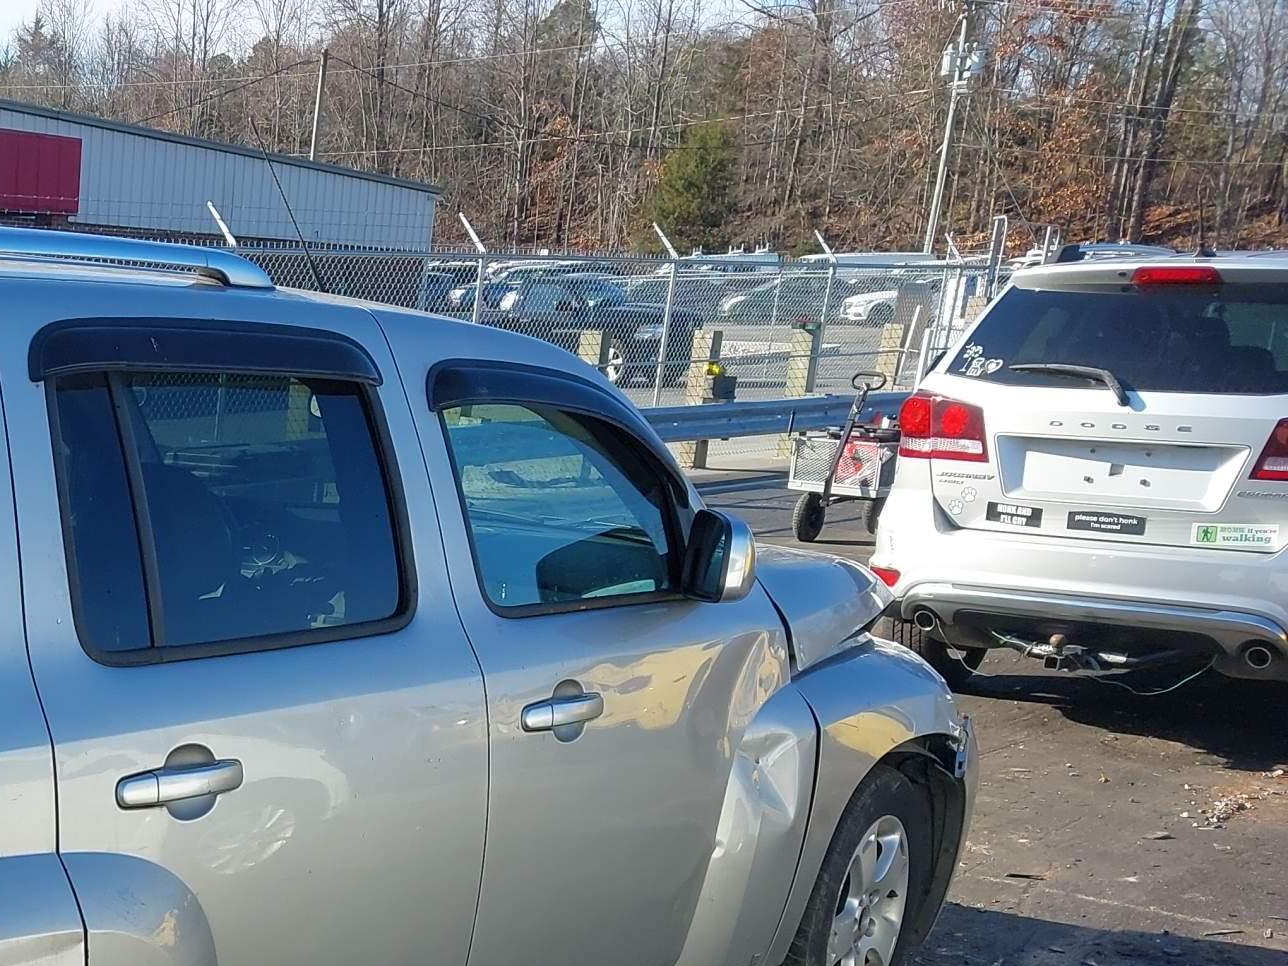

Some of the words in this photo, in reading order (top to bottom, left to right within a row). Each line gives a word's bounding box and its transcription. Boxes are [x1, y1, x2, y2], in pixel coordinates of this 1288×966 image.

[1049, 420, 1193, 433] DODGE
[1074, 514, 1098, 523] please
[1098, 515, 1118, 524] don't
[1119, 517, 1139, 525] honk
[1222, 533, 1273, 545] walking
